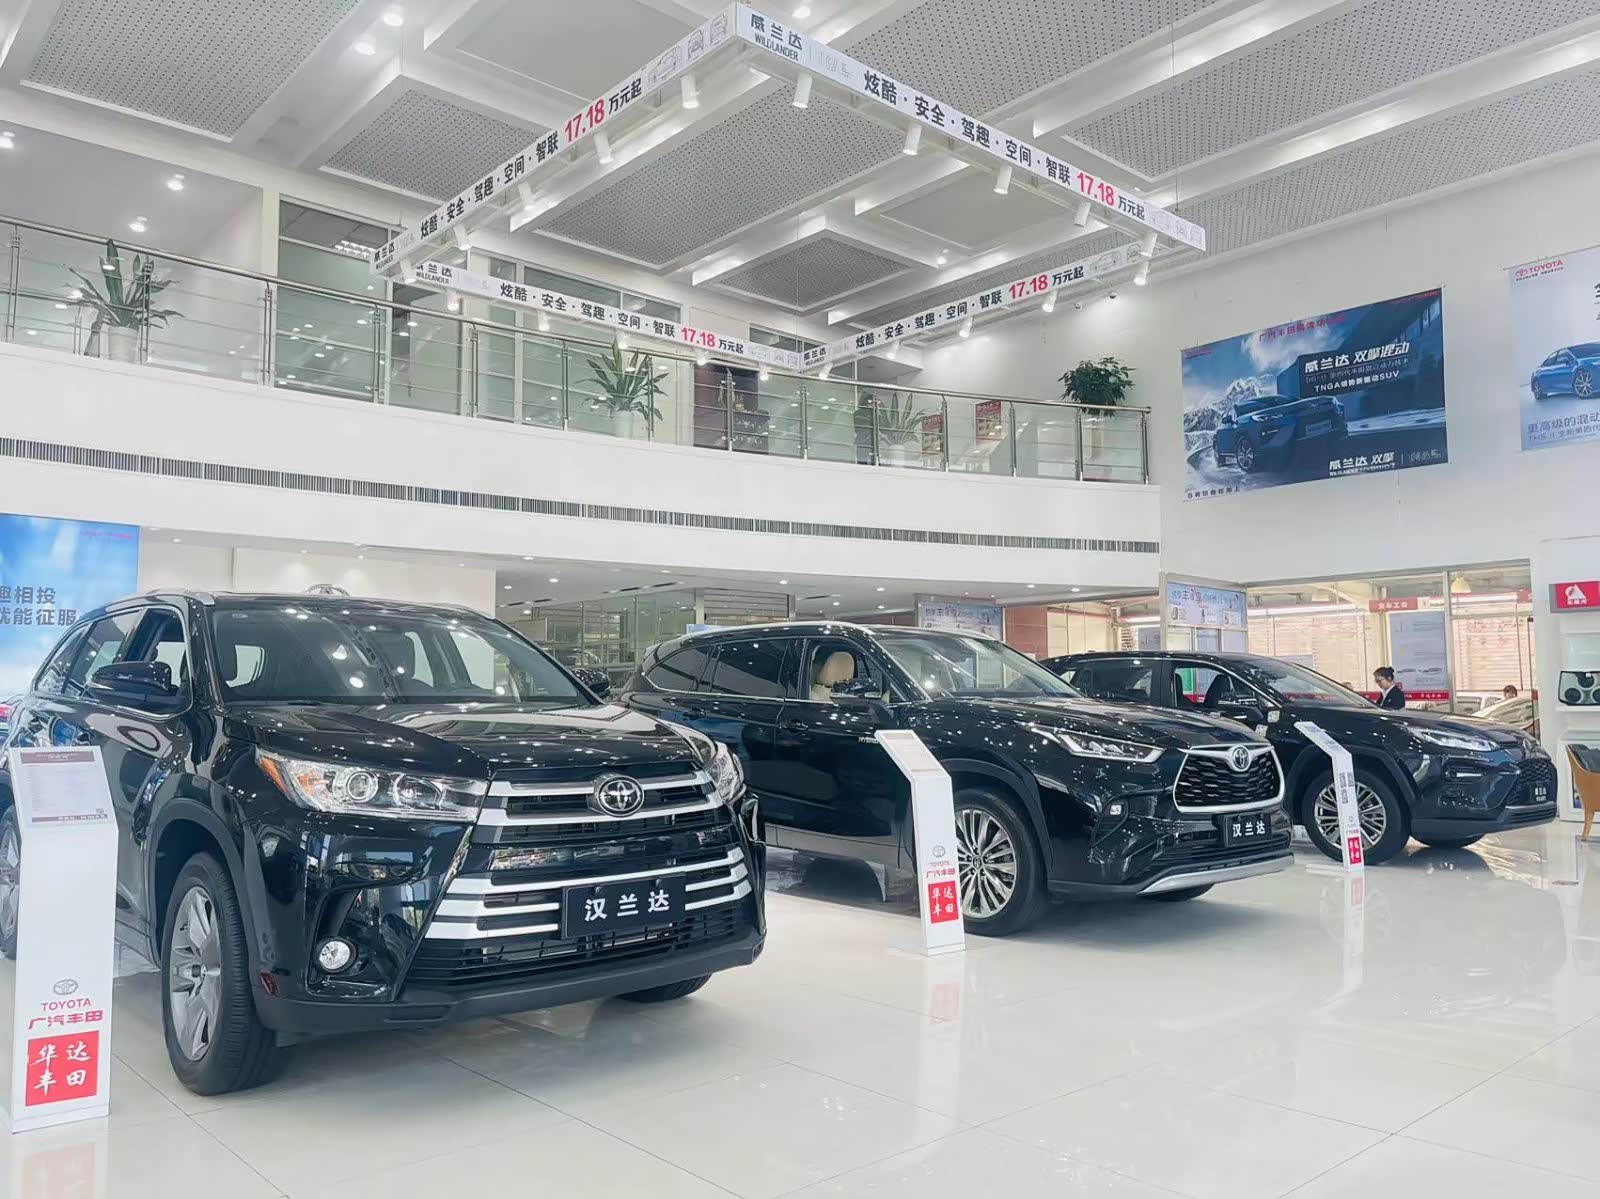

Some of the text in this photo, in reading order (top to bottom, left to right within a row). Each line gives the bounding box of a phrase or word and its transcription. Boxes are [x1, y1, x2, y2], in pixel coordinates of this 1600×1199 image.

[750, 14, 802, 50] 威兰达
[754, 33, 799, 62] WILDLANDER
[564, 98, 606, 143] 17.18
[608, 77, 643, 114] 万元起
[1076, 171, 1116, 207] 17.18
[1117, 195, 1146, 220] 万元起
[1529, 260, 1563, 273] TOYOTA
[1008, 275, 1049, 299] 17.18
[1052, 266, 1085, 286] 万元起
[680, 327, 716, 348] 17.18
[718, 339, 744, 354] 万元起
[1304, 354, 1350, 373] 威兰达
[1329, 456, 1368, 471] 威兰达
[1232, 821, 1266, 837] 汉兰达
[584, 890, 670, 922] 汉兰达
[41, 998, 92, 1011] TOYOTA
[28, 1010, 103, 1030] 广汽丰田
[32, 1040, 91, 1068] 华达
[34, 1069, 87, 1096] 丰田
